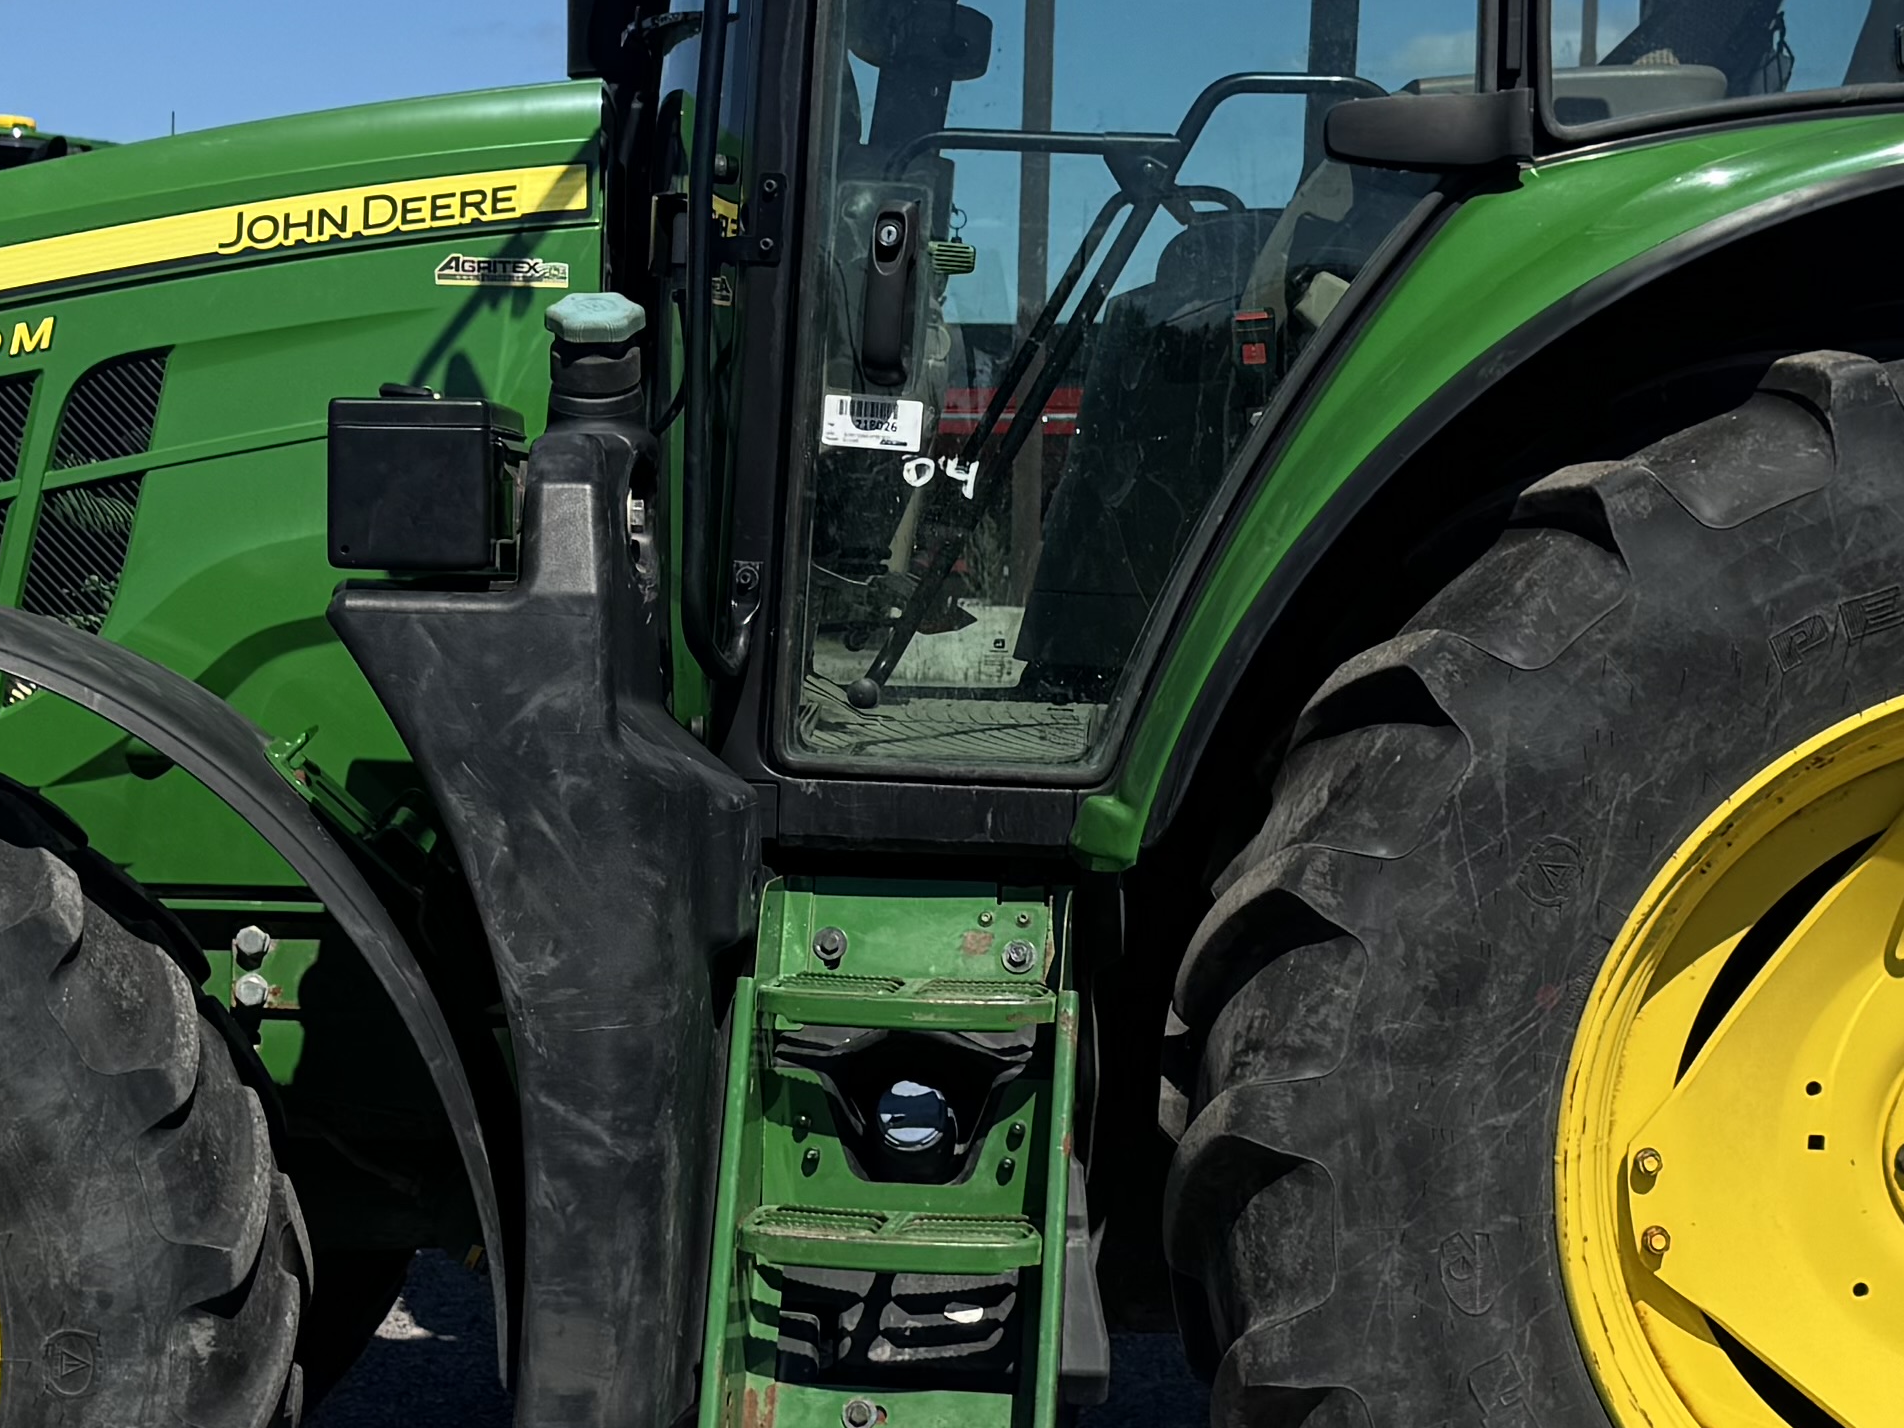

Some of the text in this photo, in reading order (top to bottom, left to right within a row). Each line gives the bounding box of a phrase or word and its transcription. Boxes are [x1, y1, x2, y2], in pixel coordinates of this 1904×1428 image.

[217, 184, 518, 249] JOHN DEERE
[438, 255, 542, 274] AGRITEX
[9, 316, 55, 356] M
